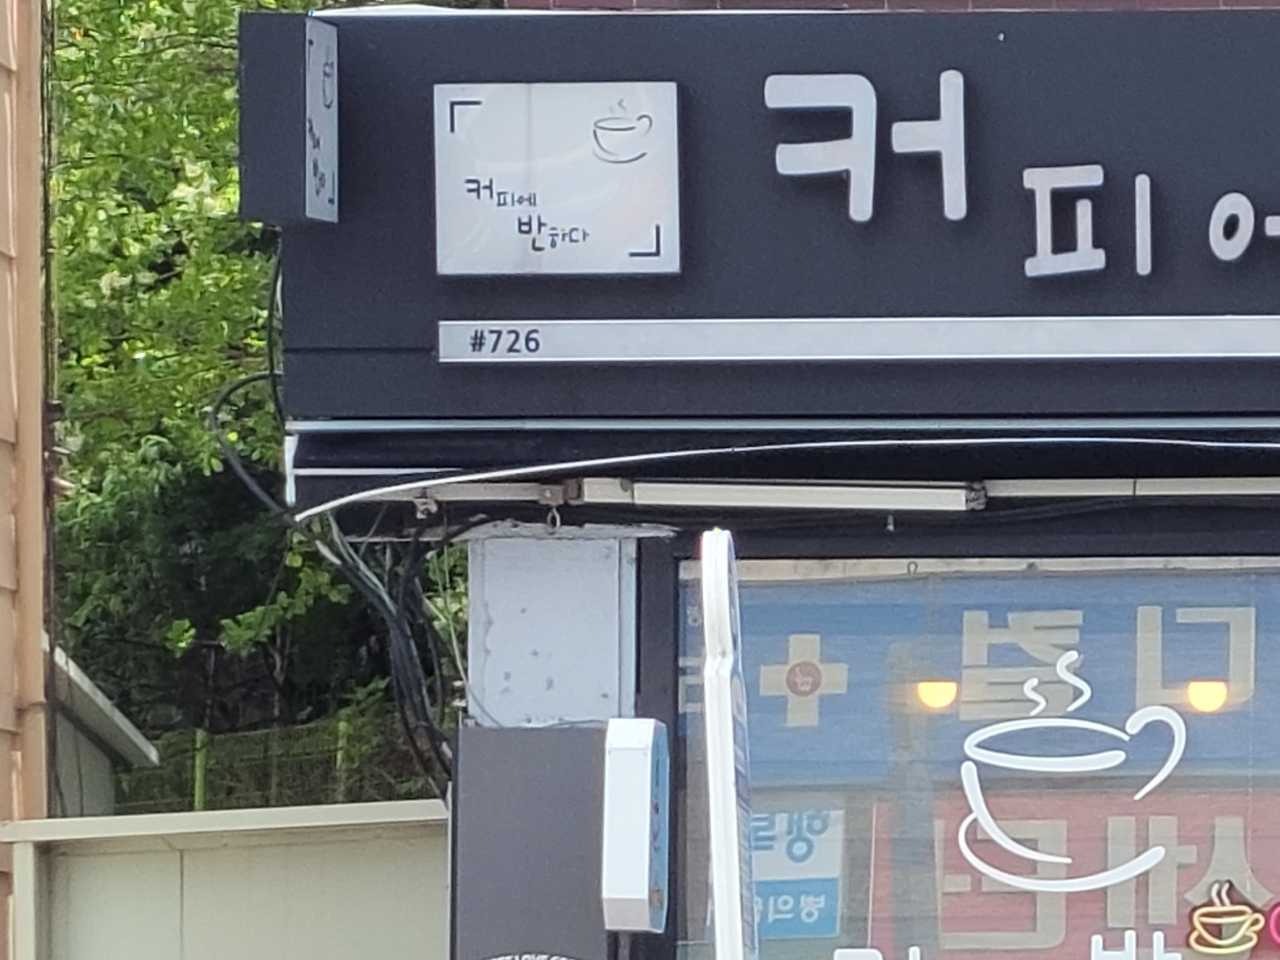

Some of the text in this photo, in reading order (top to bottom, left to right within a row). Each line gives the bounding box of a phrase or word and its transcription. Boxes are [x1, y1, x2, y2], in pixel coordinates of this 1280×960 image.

[465, 178, 538, 208] 커피에
[517, 215, 590, 253] 반하다
[469, 327, 542, 355] #726
